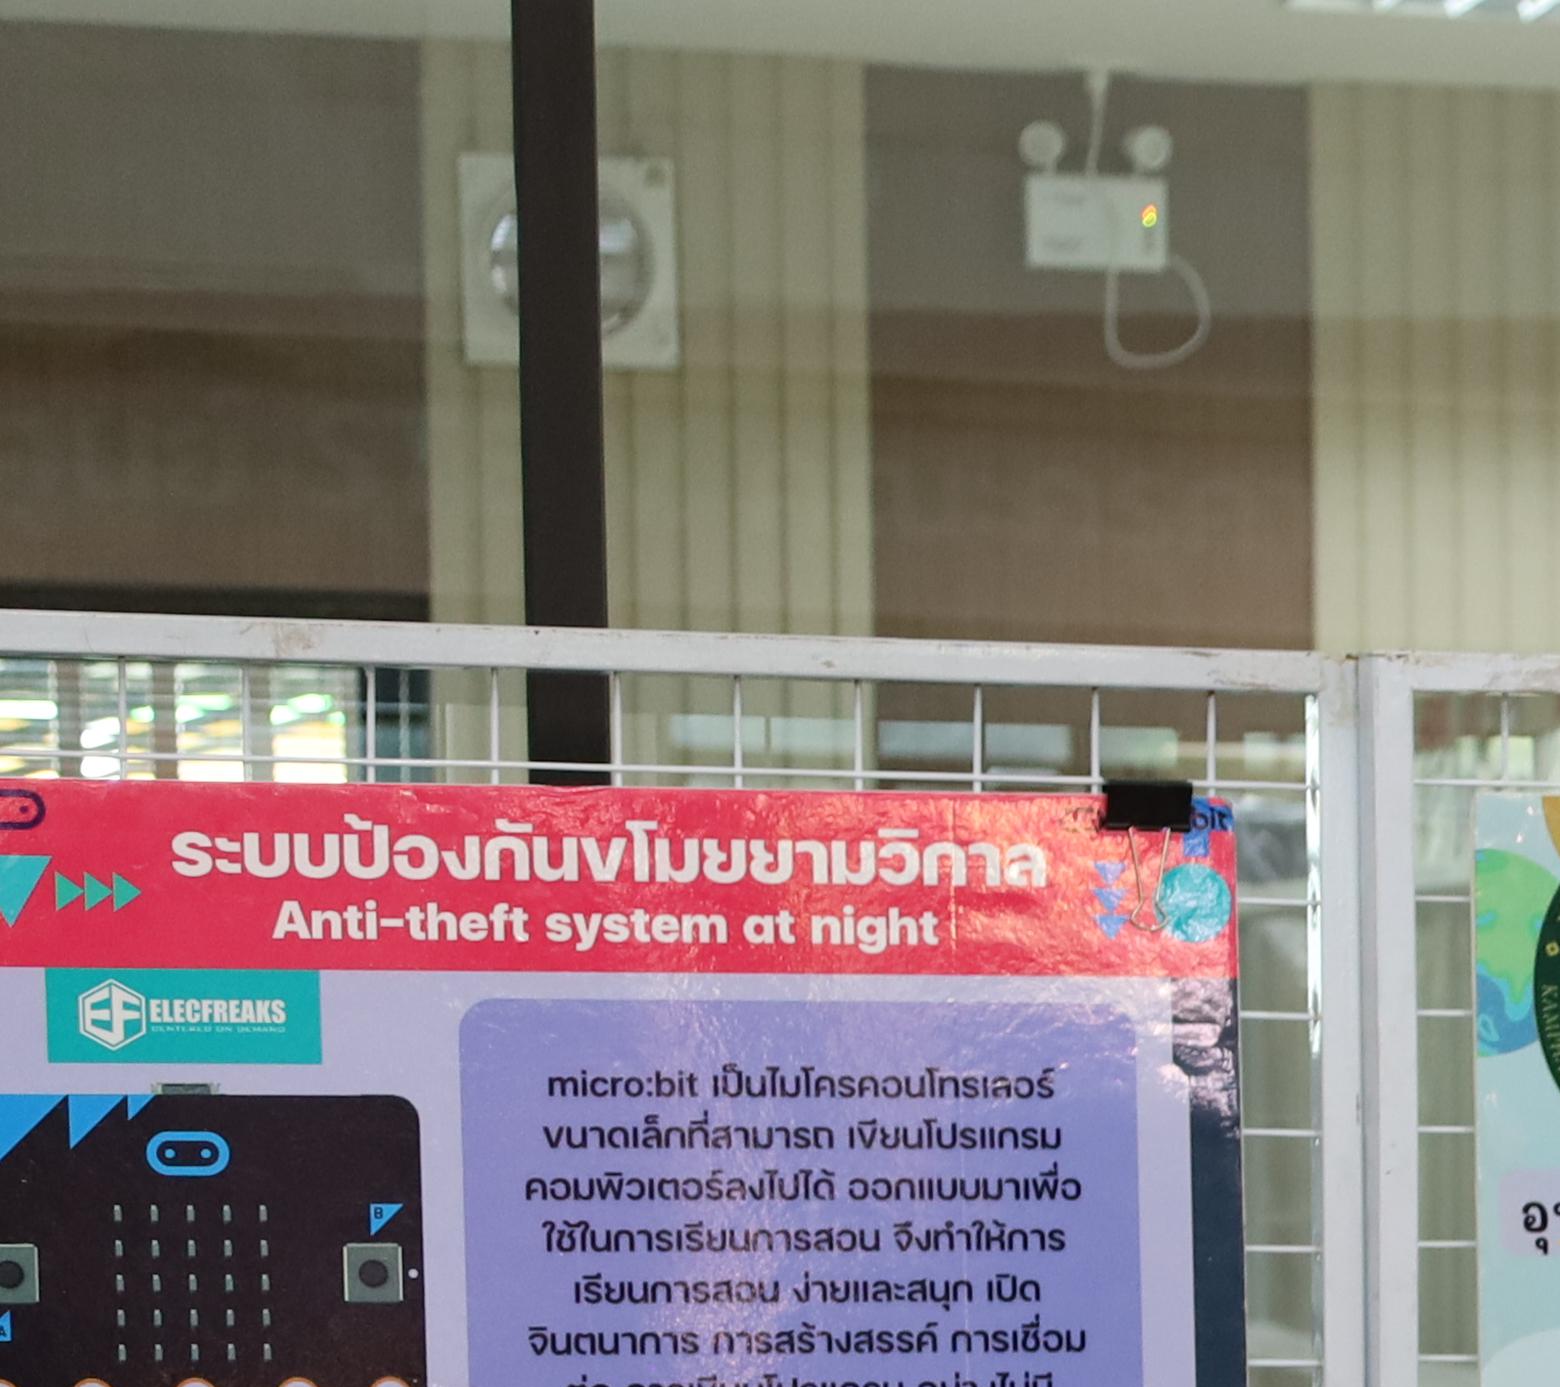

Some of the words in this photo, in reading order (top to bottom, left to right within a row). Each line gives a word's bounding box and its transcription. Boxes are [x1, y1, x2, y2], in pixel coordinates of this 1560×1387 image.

[172, 813, 1046, 888] ระบบป้องกันขโมยยามวิกาล
[272, 900, 529, 944] Anti-theft
[545, 905, 727, 952] system
[743, 910, 795, 944] at
[810, 907, 939, 953] night
[150, 998, 287, 1023] ELECFREAKS
[547, 1069, 697, 1098] micro:bit
[713, 1066, 1055, 1100] เป็นไมโครคอนโทรเลอร์
[543, 1111, 835, 1151] ขนาดเล็กที่สามารถ
[848, 1118, 1062, 1150] เขียนโปรแกรม
[525, 1169, 836, 1202] คอมพิวเตอร์ลงไปได้
[848, 1161, 1082, 1201] ออกแบบมาเพื่อ
[373, 1207, 384, 1220] B
[542, 1221, 881, 1253] ใช้ในการเรียนการสอน
[893, 1219, 1066, 1252] จึงทำให้การ
[573, 1274, 780, 1306] เรียนการสอน
[793, 1271, 973, 1312] ง่ายและสนุก
[986, 1273, 1040, 1303] เปิด
[528, 1326, 699, 1358] จินตนาการ
[713, 1322, 939, 1356] การสร้างสรรค์
[951, 1313, 1086, 1355] การเชื่อม
